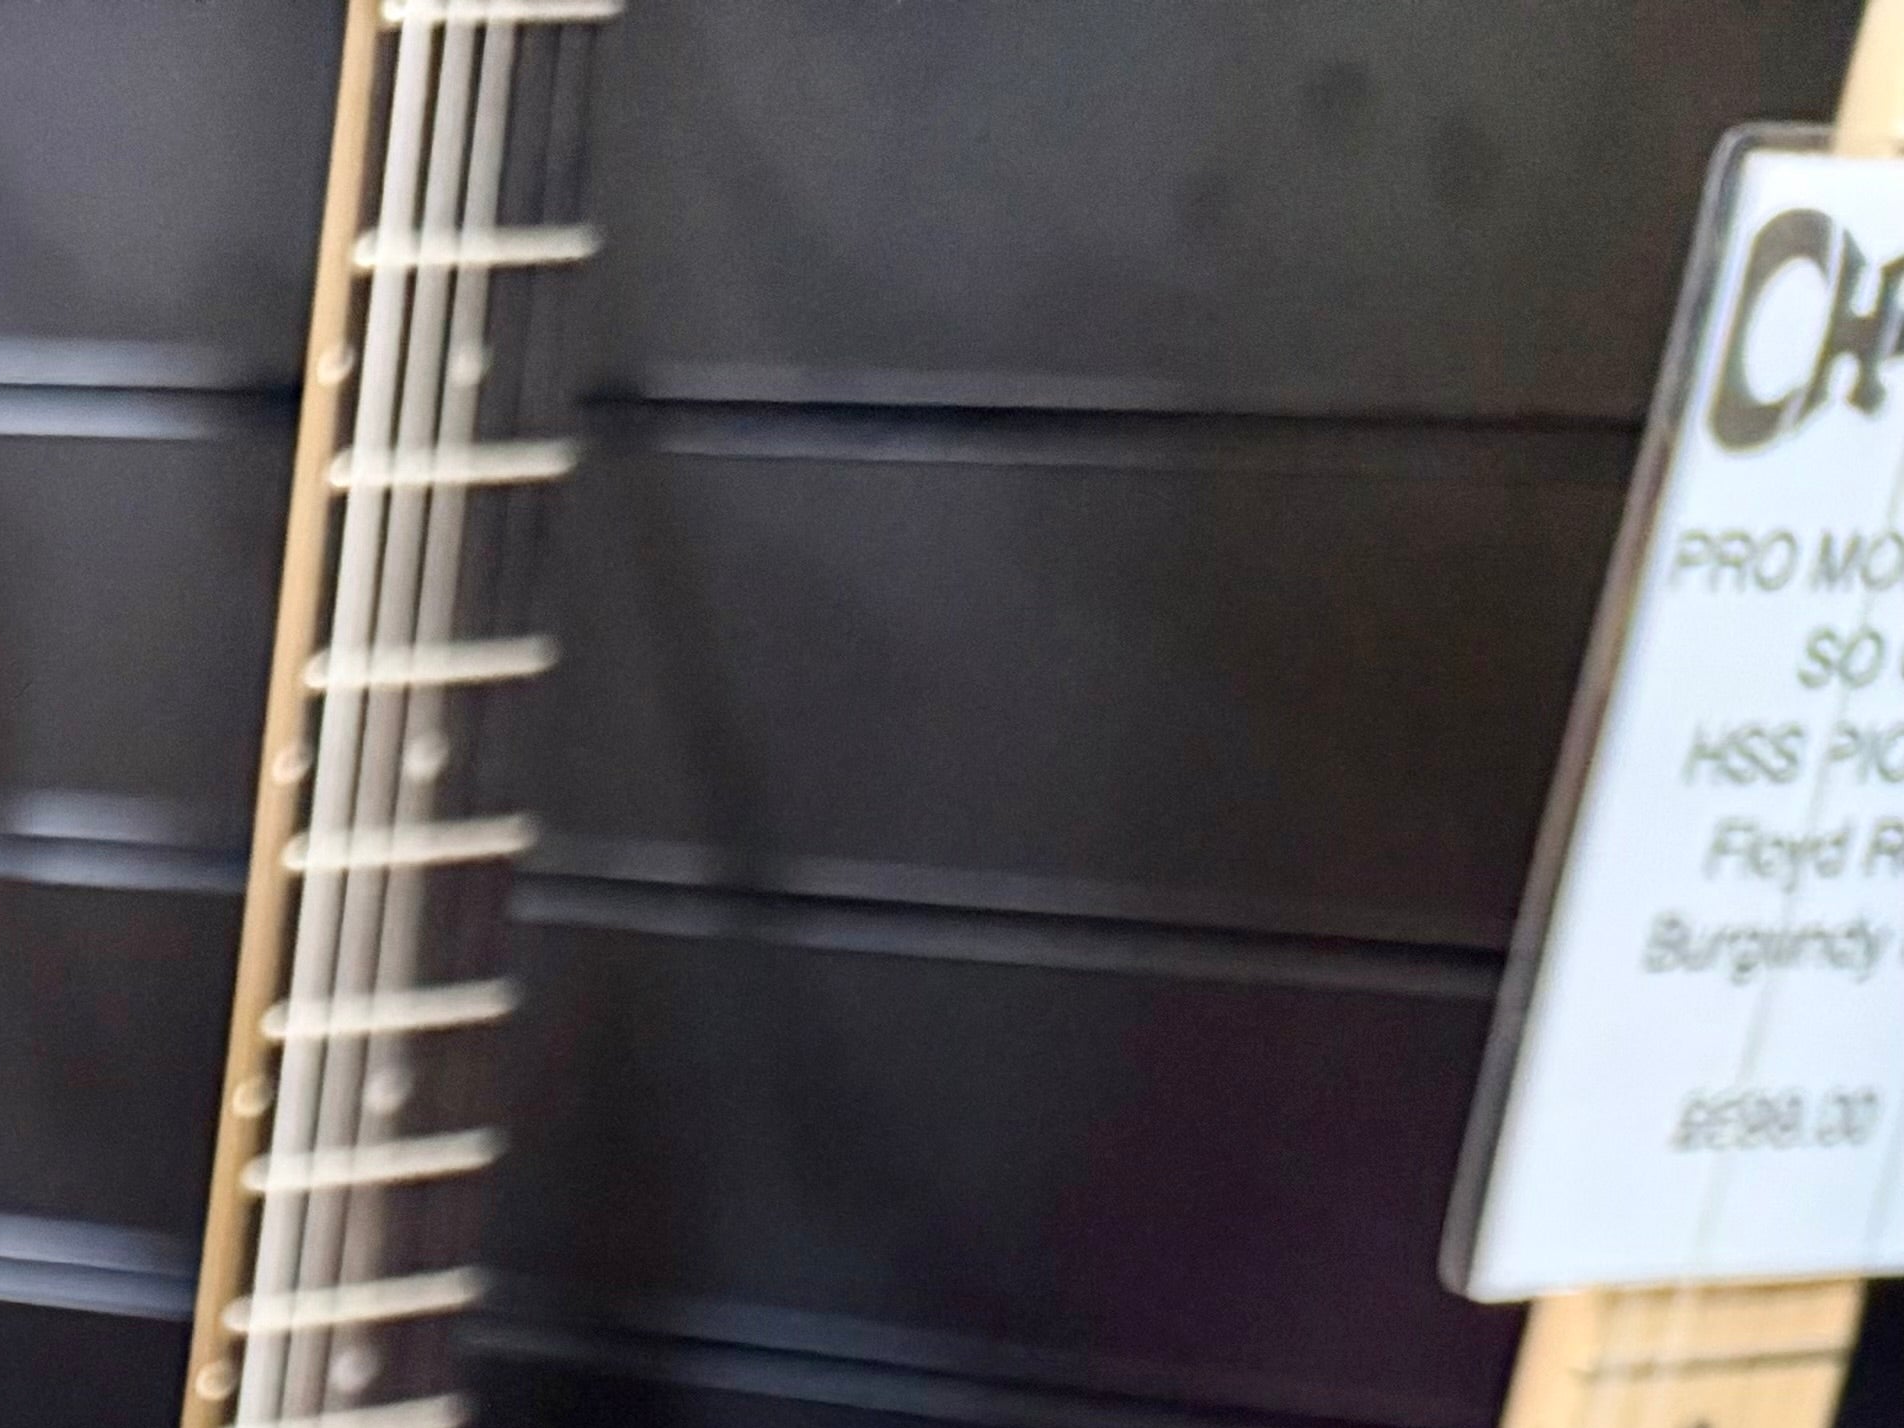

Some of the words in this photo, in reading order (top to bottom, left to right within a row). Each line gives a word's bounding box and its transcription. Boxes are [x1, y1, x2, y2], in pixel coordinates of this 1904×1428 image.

[1707, 207, 1904, 454] CH
[1672, 527, 1796, 592] PRO
[1796, 626, 1885, 690] SO
[1682, 722, 1806, 788] HSS
[1703, 813, 1853, 893] Floyd
[1641, 911, 1886, 985] Burgundy
